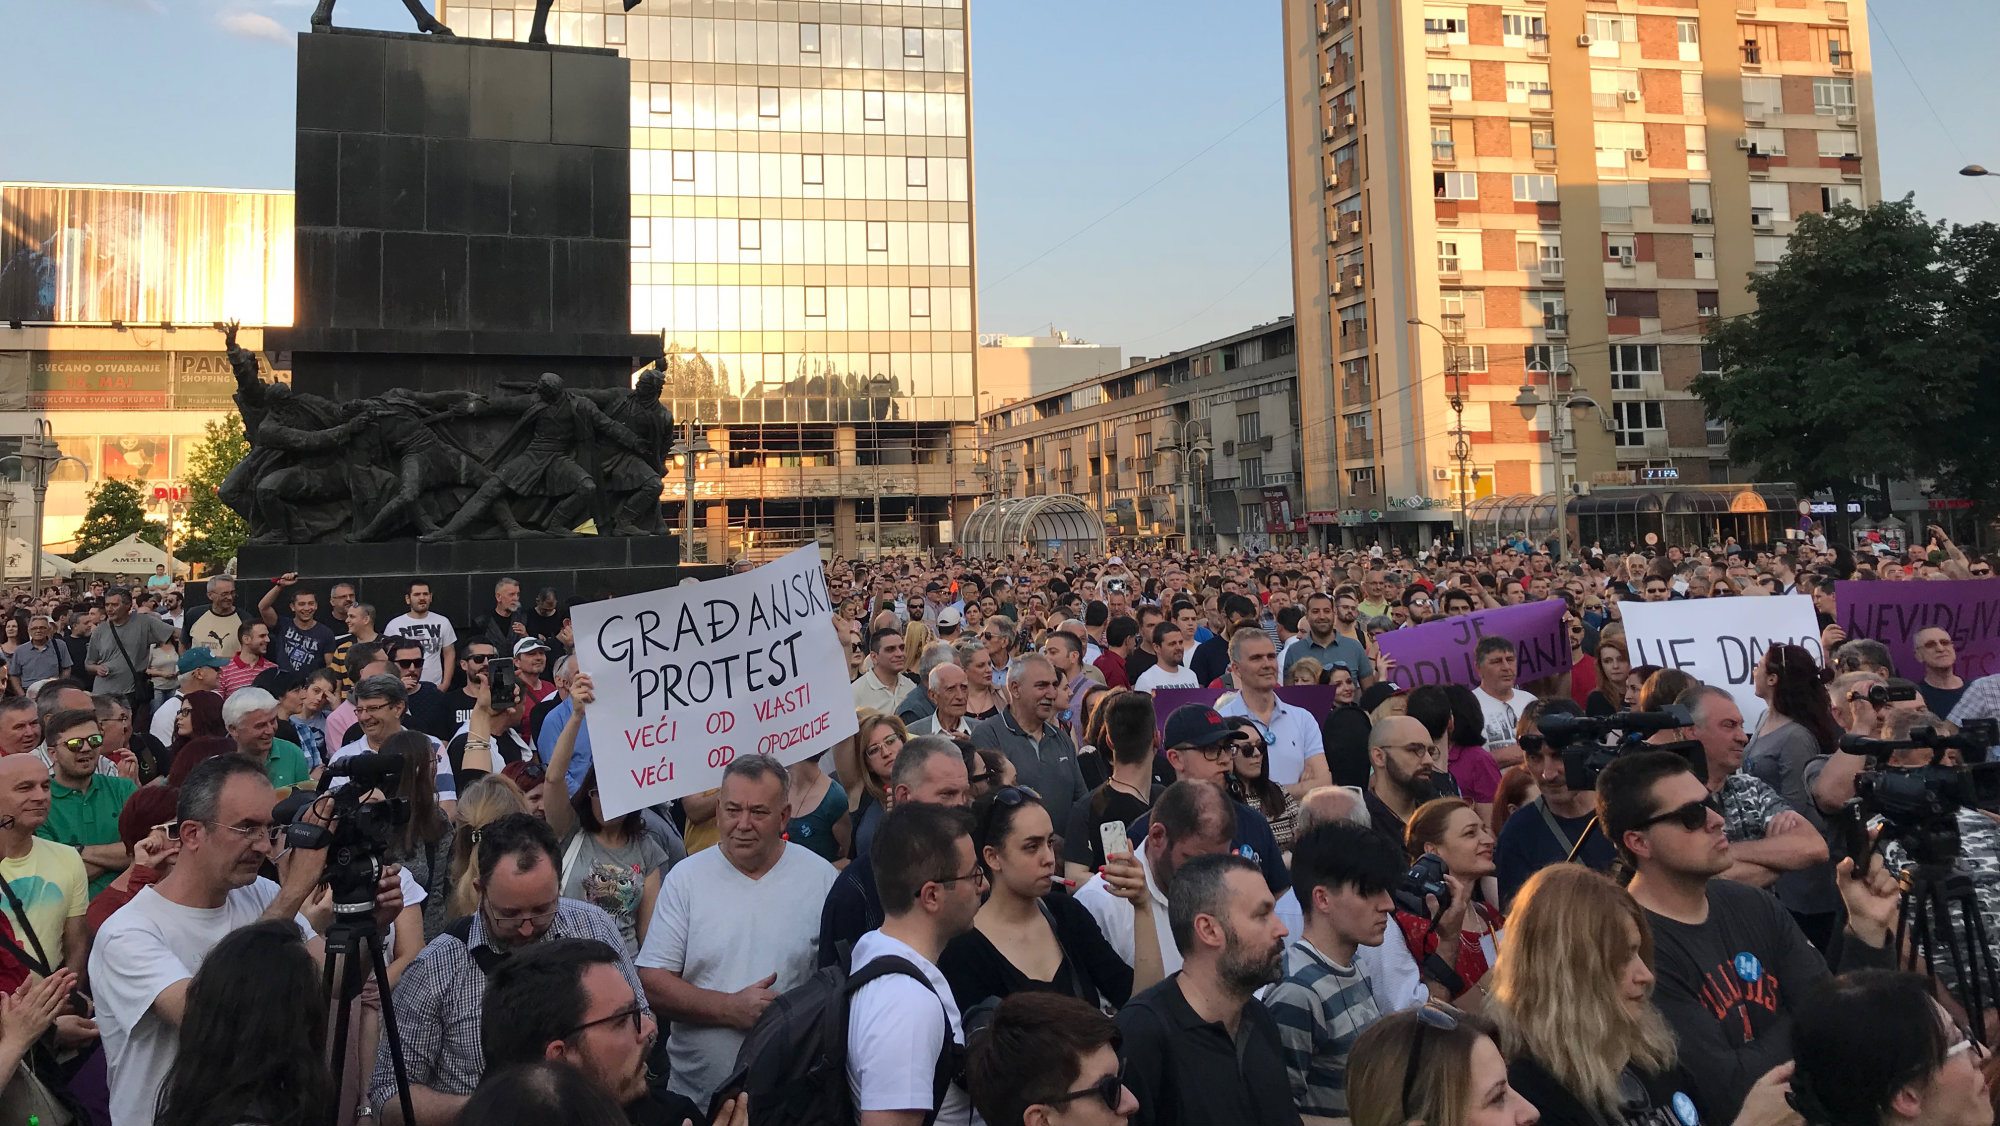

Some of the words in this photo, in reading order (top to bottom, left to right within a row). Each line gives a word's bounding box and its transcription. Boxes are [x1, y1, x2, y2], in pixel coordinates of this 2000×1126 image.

[95, 364, 161, 373] OTVARANJE
[181, 355, 269, 374] PANA
[181, 375, 231, 383] SHOPPING
[398, 624, 441, 638] NEW
[597, 565, 832, 673] GRAĐANSKI
[631, 630, 802, 717] PROTEST
[624, 715, 677, 751] VEĆI
[706, 711, 735, 734] OD
[753, 682, 811, 722] VLASTI
[631, 756, 674, 789] VEĆI
[707, 745, 735, 768] OD
[757, 711, 831, 756] OPOZICIJE
